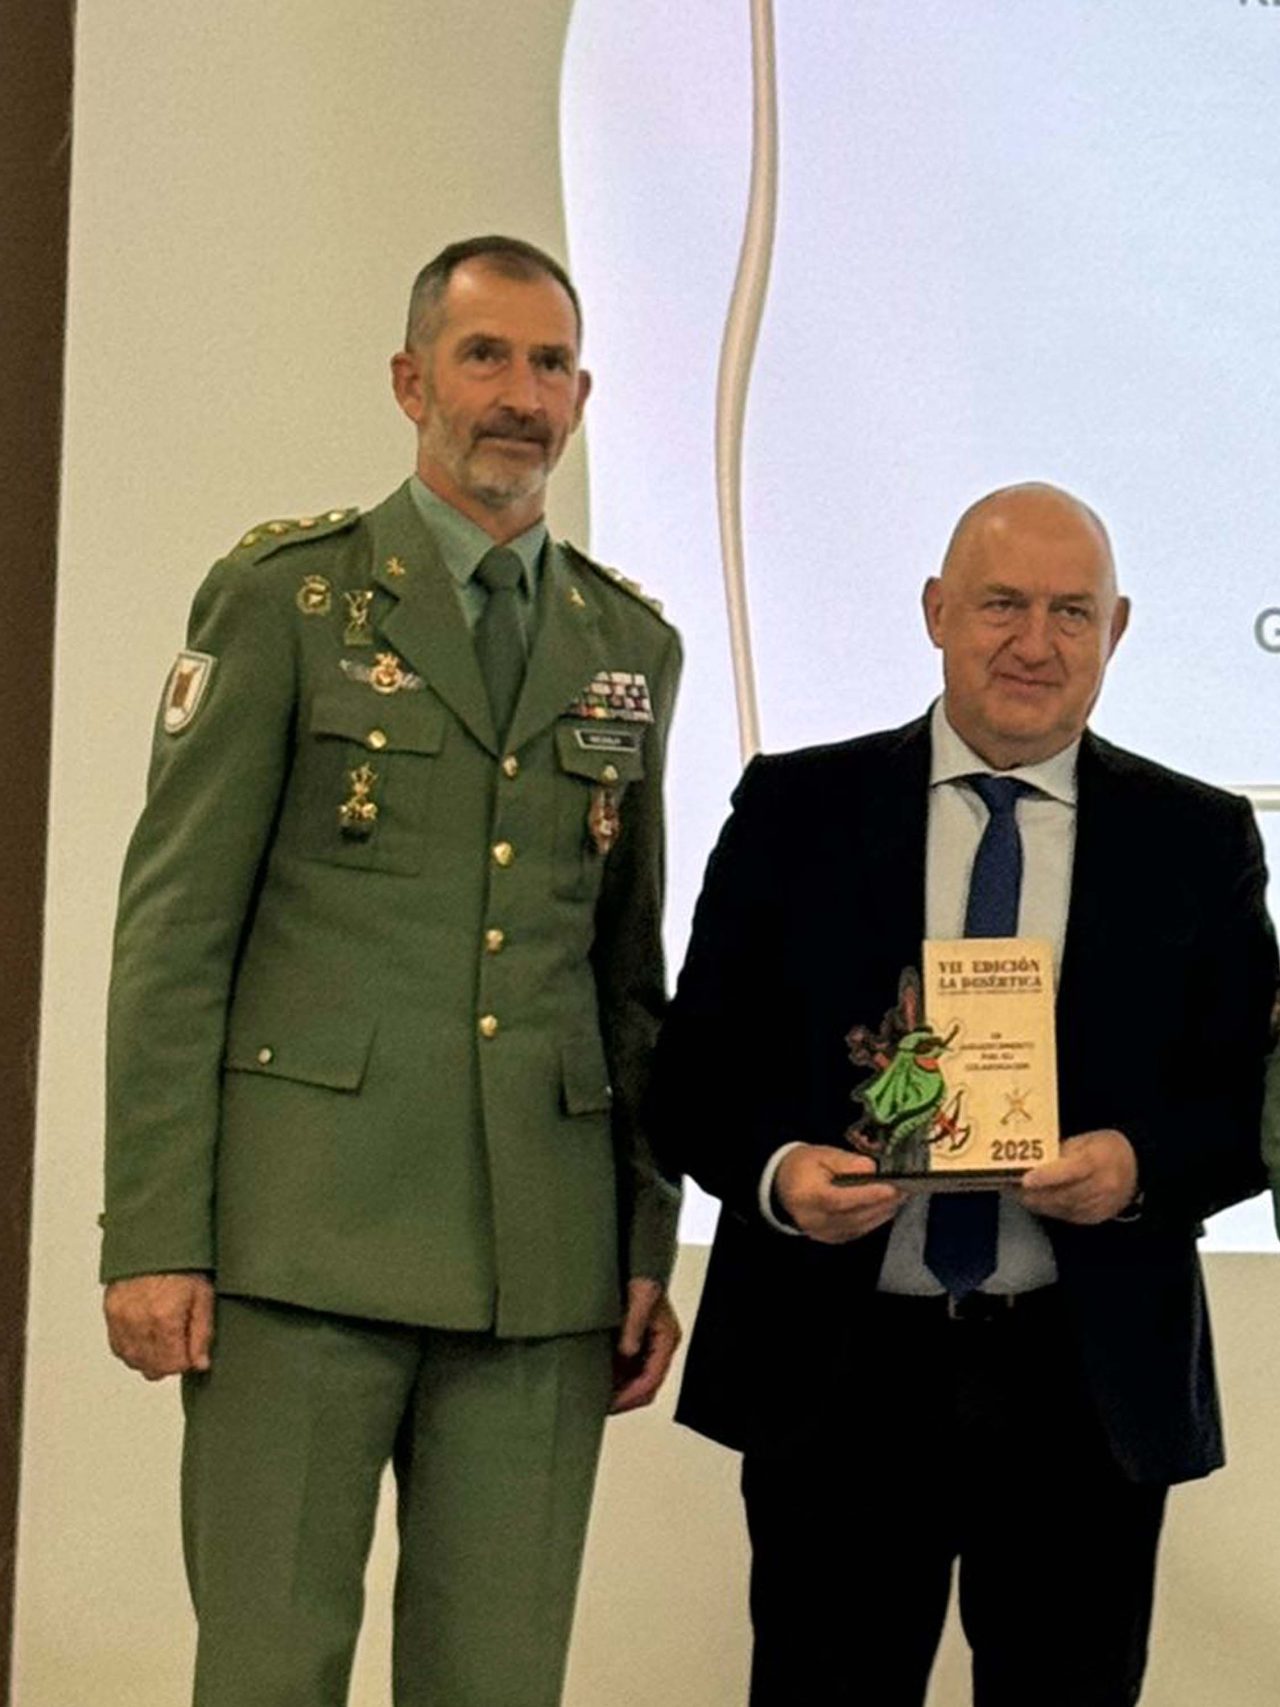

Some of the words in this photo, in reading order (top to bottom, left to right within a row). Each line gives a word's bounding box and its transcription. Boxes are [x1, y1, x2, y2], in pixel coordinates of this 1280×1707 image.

[938, 960, 963, 975] VII
[972, 956, 1041, 975] EDICIÓN
[991, 1139, 1045, 1161] 2025
